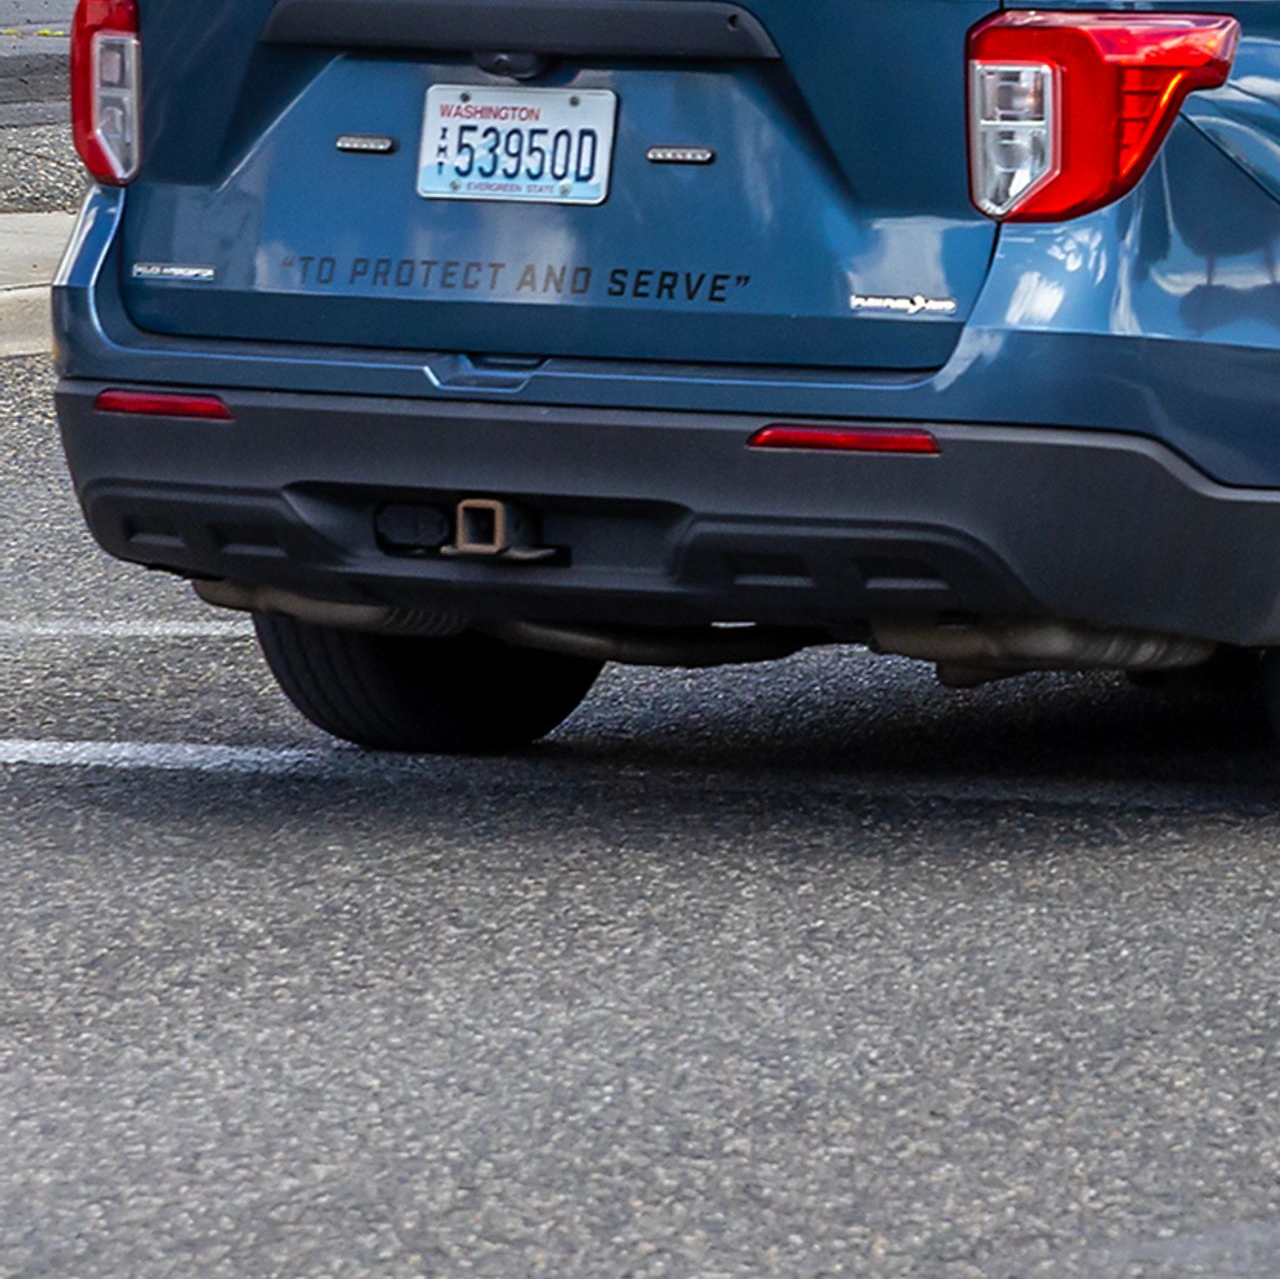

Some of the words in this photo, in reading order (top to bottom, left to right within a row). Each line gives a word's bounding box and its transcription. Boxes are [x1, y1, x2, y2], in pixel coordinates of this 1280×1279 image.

[439, 103, 541, 122] WASHINGTON
[454, 124, 598, 182] 53950D
[349, 257, 506, 292] PROTECT
[516, 263, 592, 295] AND
